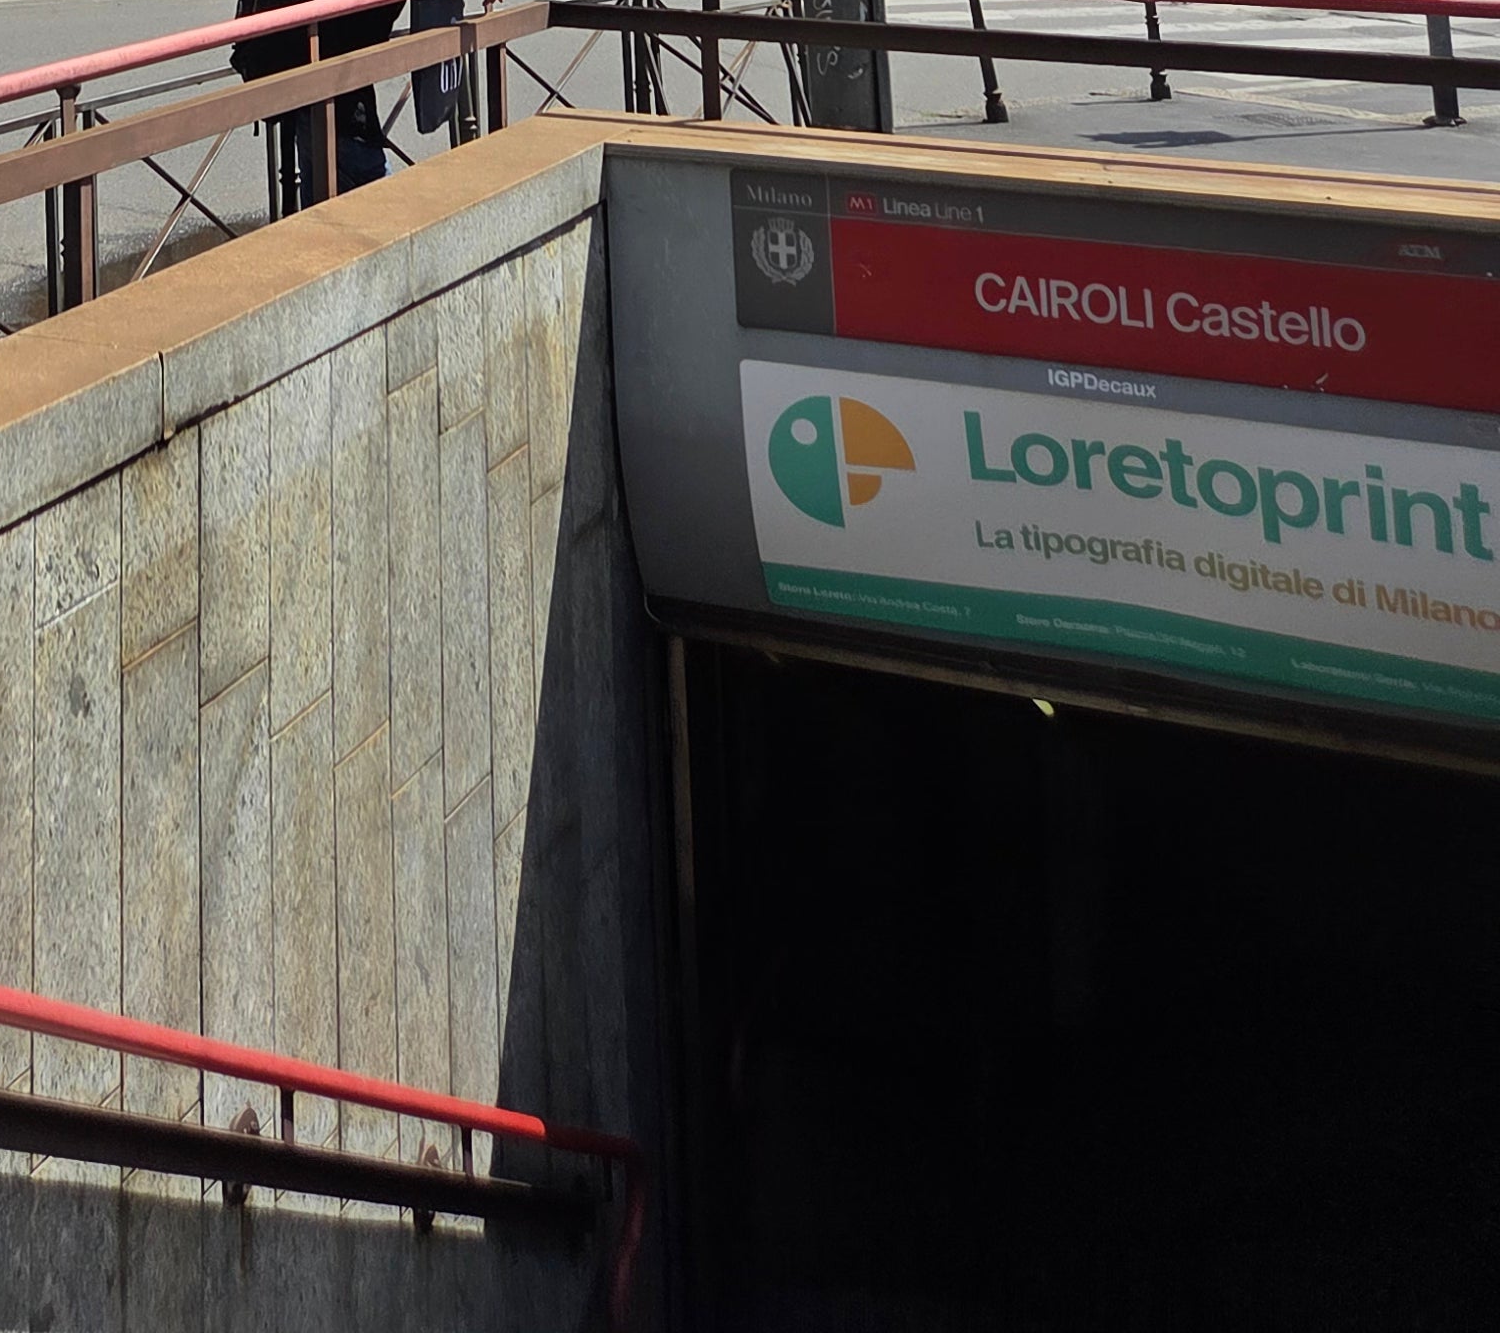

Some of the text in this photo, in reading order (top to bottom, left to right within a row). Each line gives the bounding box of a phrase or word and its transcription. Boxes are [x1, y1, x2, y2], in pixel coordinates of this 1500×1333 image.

[747, 184, 812, 207] Milano
[850, 196, 984, 224] M1 Linea Line 1
[974, 272, 1367, 352] CAIROLI Castello
[1047, 368, 1157, 398] IGPDecaux
[963, 411, 1496, 561] Loretoprint
[975, 520, 1500, 633] La tipografia digitale di Milano
